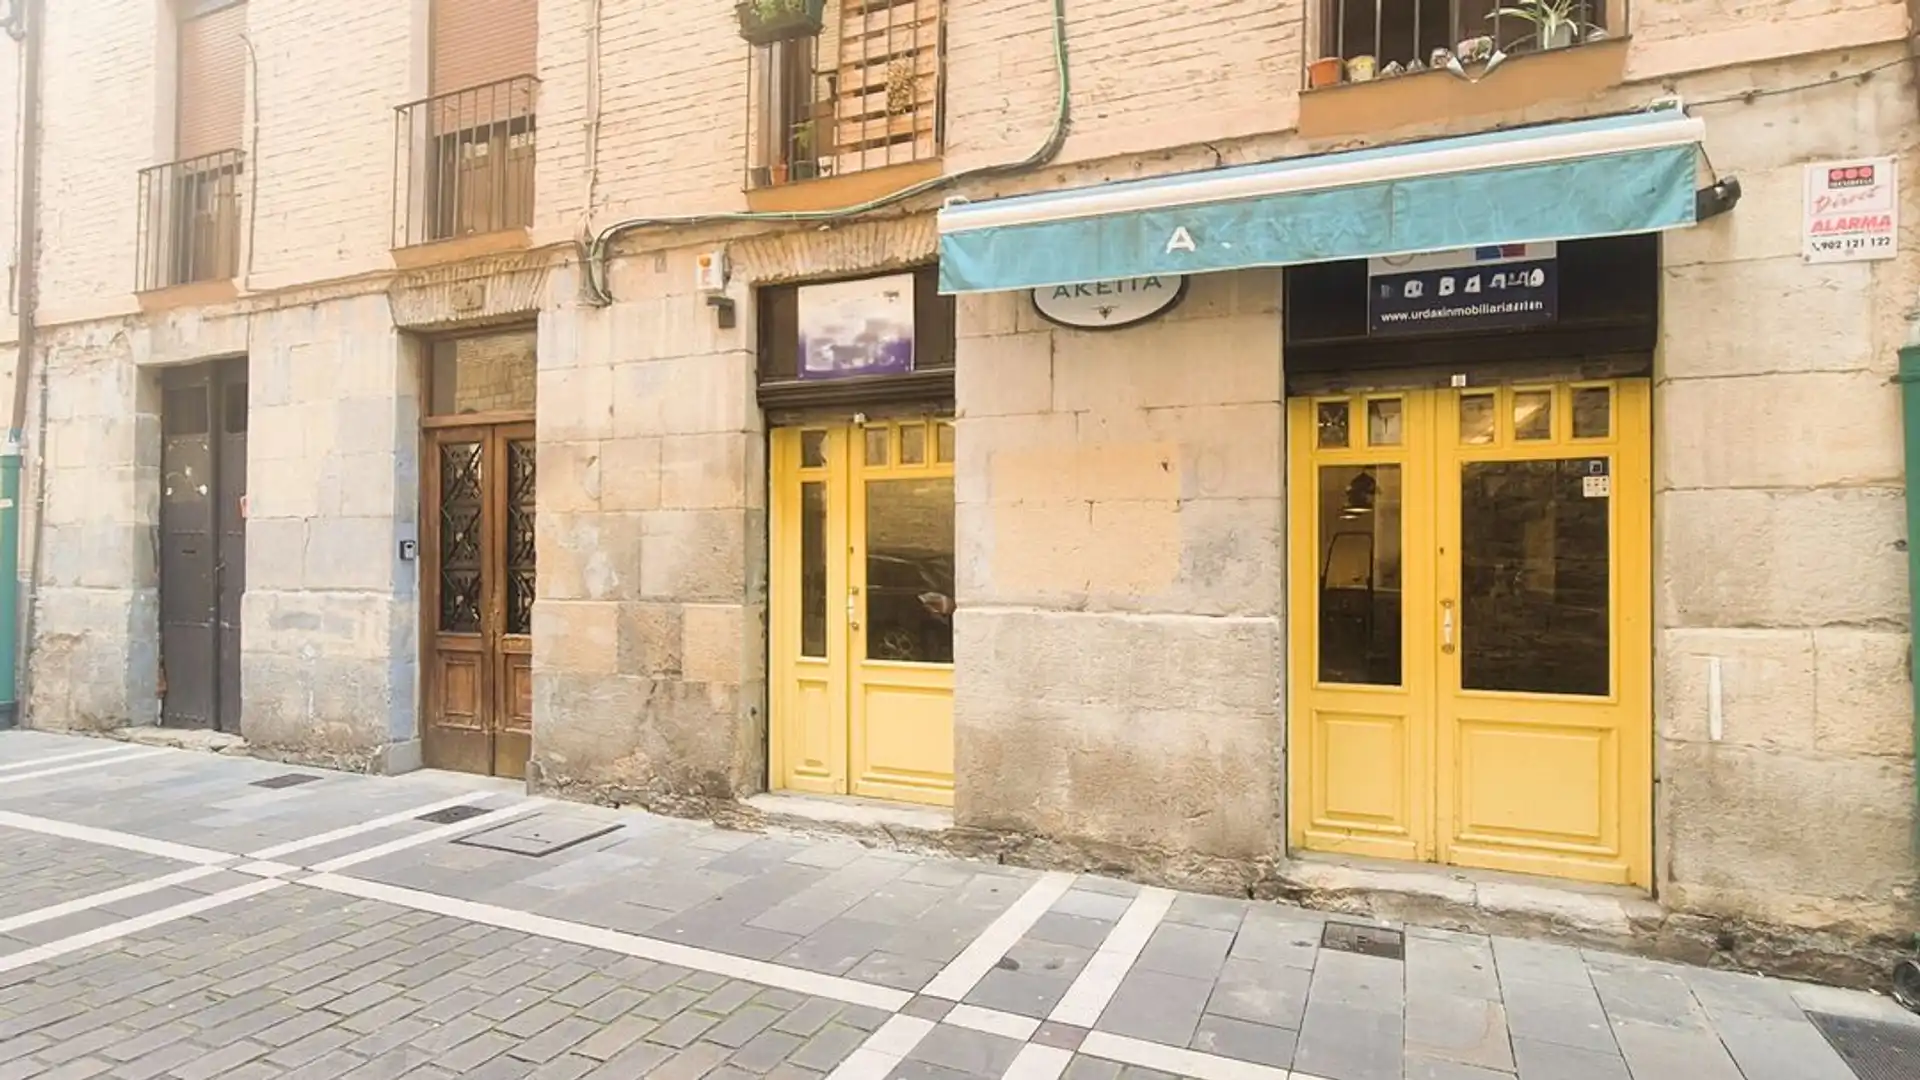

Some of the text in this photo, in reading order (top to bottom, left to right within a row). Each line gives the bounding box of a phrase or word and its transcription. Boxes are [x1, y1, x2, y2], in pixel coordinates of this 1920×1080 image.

[1811, 215, 1890, 233] ALARMA
[1821, 236, 1891, 250] 902 121 122
